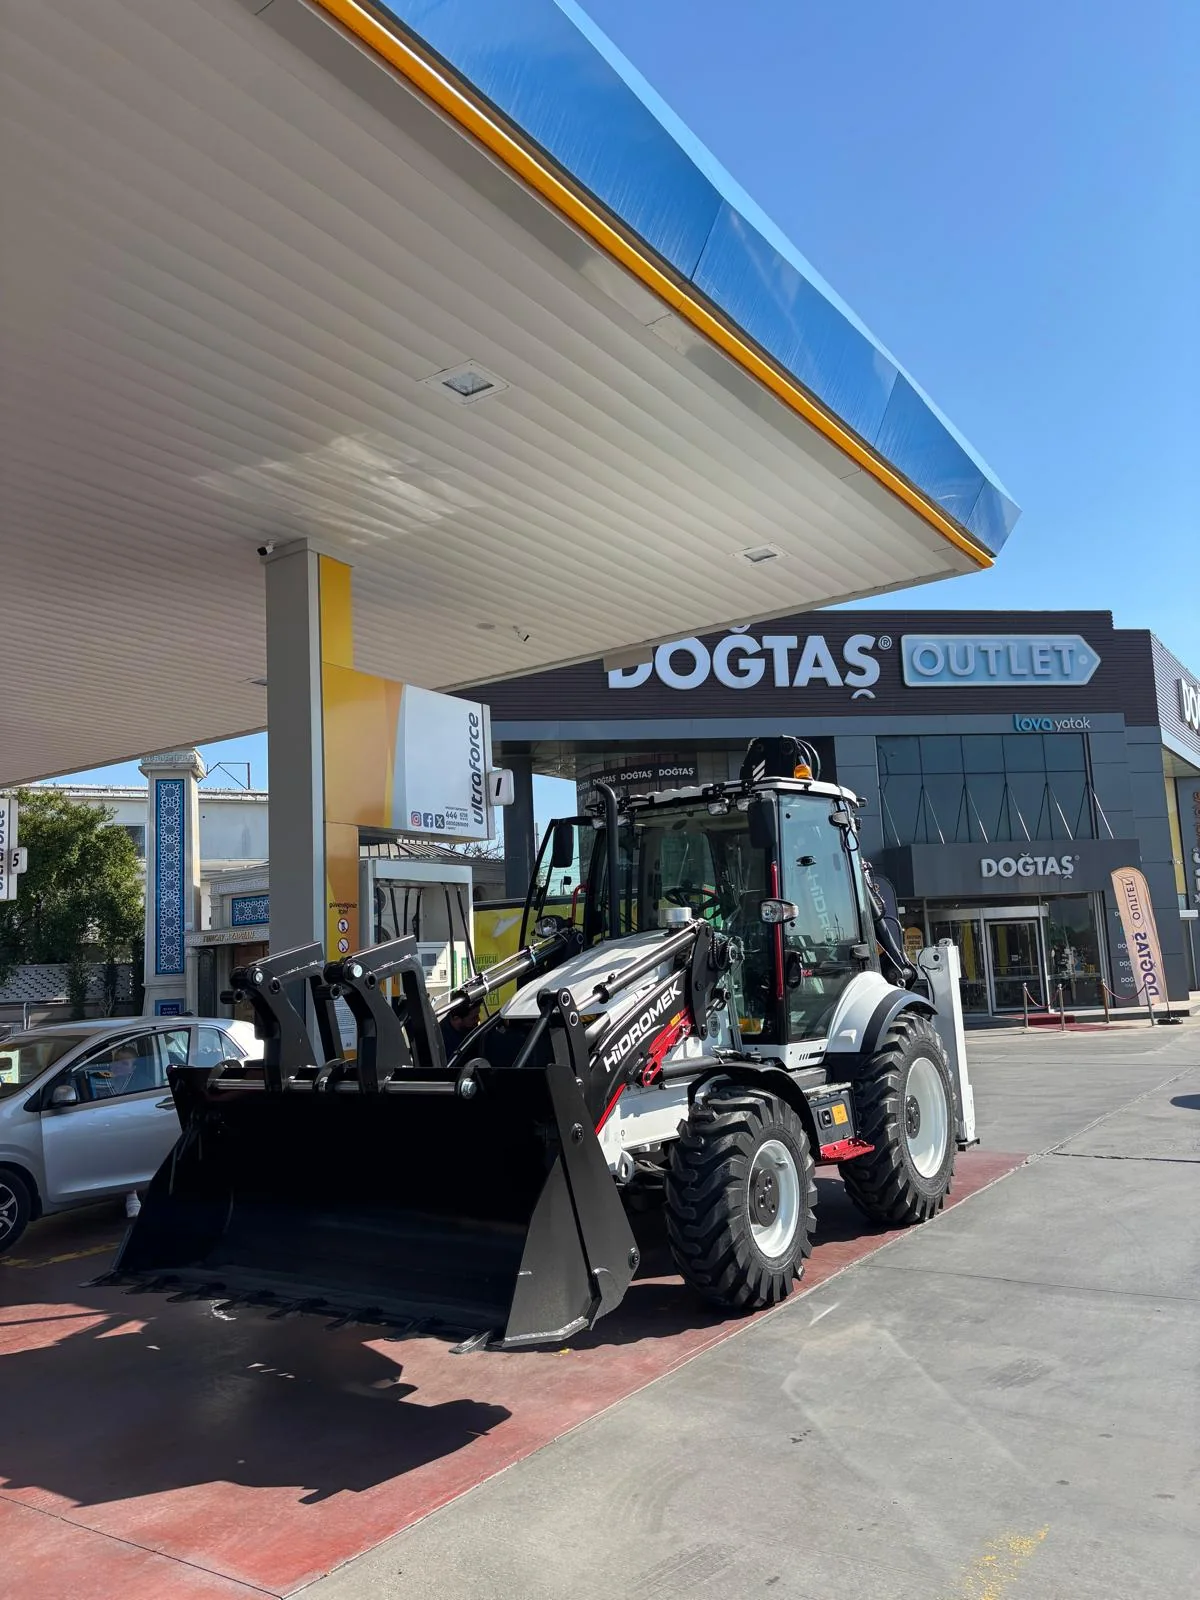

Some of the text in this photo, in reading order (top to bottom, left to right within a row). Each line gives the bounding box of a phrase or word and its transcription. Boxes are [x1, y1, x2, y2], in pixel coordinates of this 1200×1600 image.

[912, 642, 1077, 676] OUTLET
[1012, 713, 1091, 731] lova yatak
